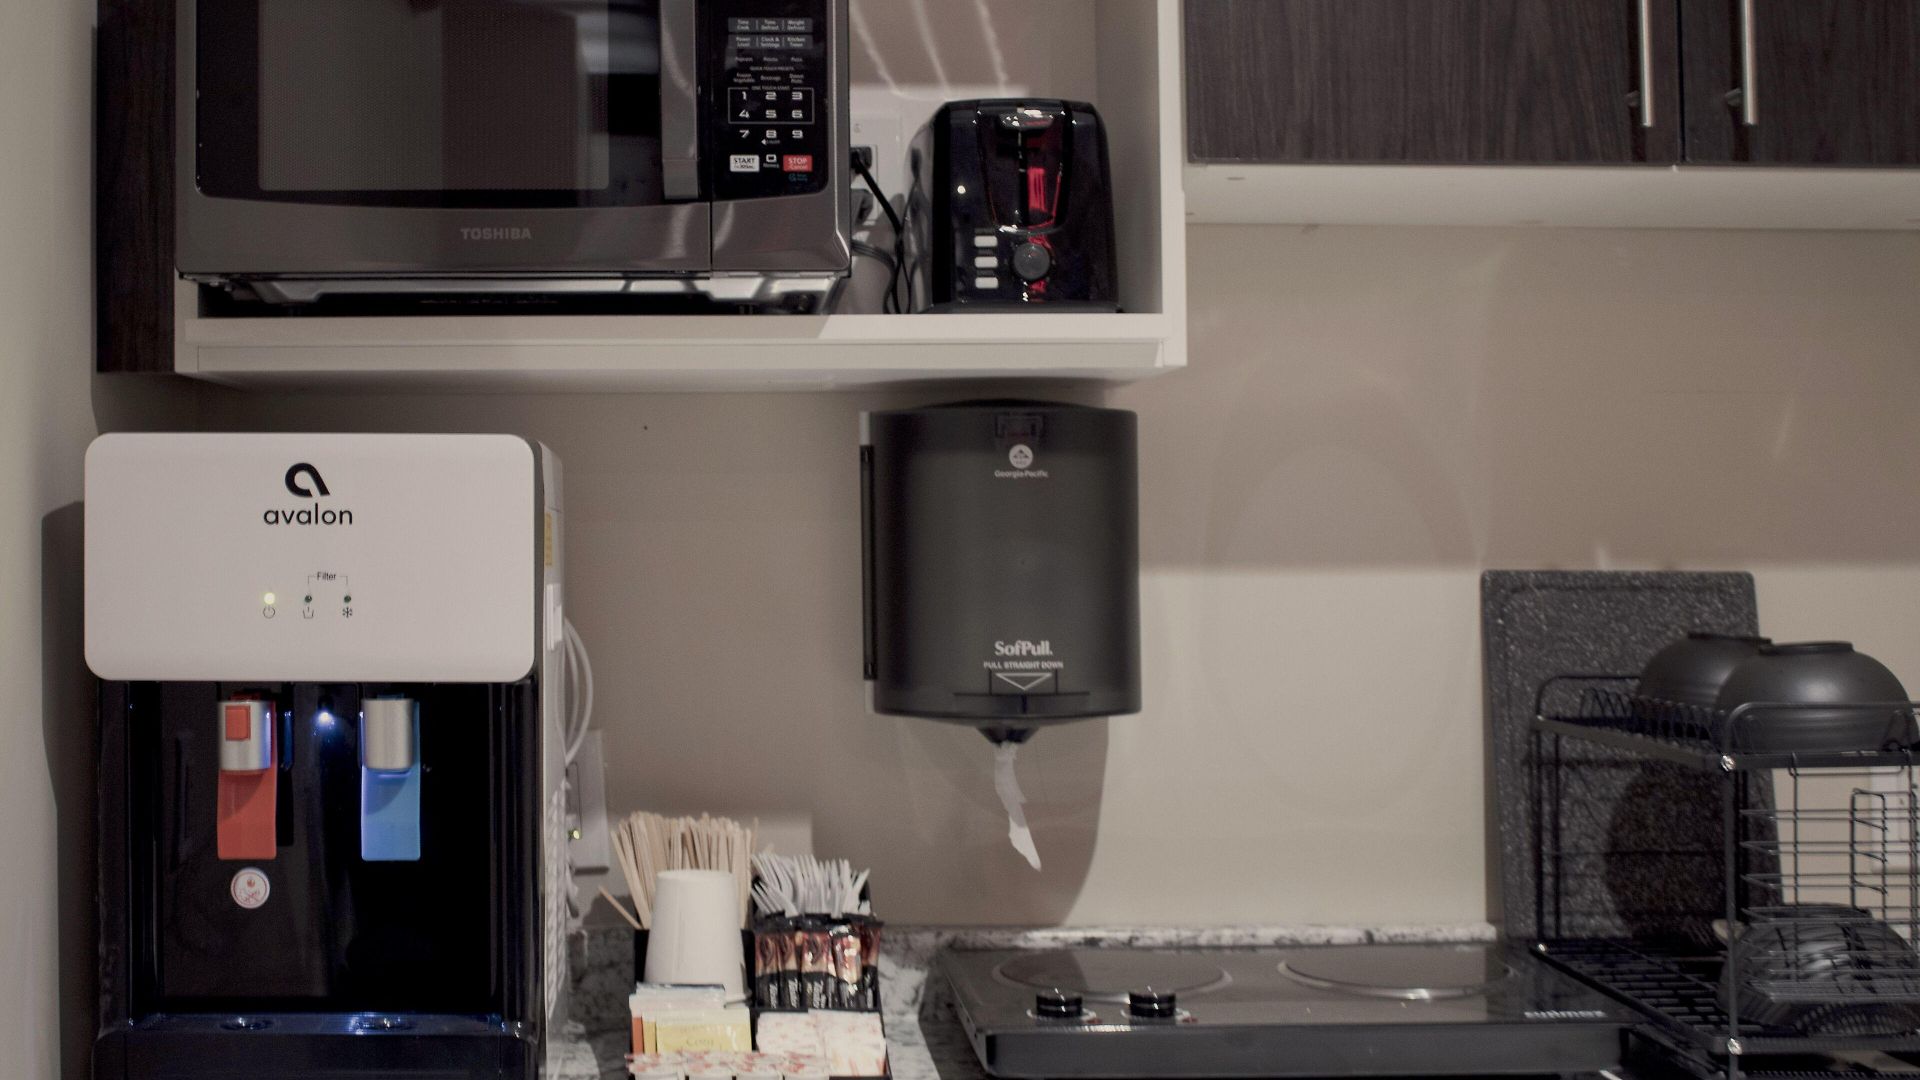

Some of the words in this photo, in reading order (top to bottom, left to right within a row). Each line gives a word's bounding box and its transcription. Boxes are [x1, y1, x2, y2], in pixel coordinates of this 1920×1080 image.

[742, 91, 747, 100] 1
[765, 91, 777, 100] 2
[792, 91, 803, 100] 3
[739, 109, 750, 118] 4
[765, 109, 777, 118] 5
[792, 109, 803, 118] 6
[739, 130, 750, 138] 7
[765, 130, 777, 138] 8
[792, 130, 803, 138] 9
[766, 154, 777, 162] 0
[460, 227, 533, 240] TOSHIBA
[263, 502, 353, 525] avalon
[316, 571, 337, 581] Filter
[983, 661, 1003, 669] PULL
[1003, 661, 1040, 669] STRAIGHT
[1041, 661, 1064, 669] DOWN
